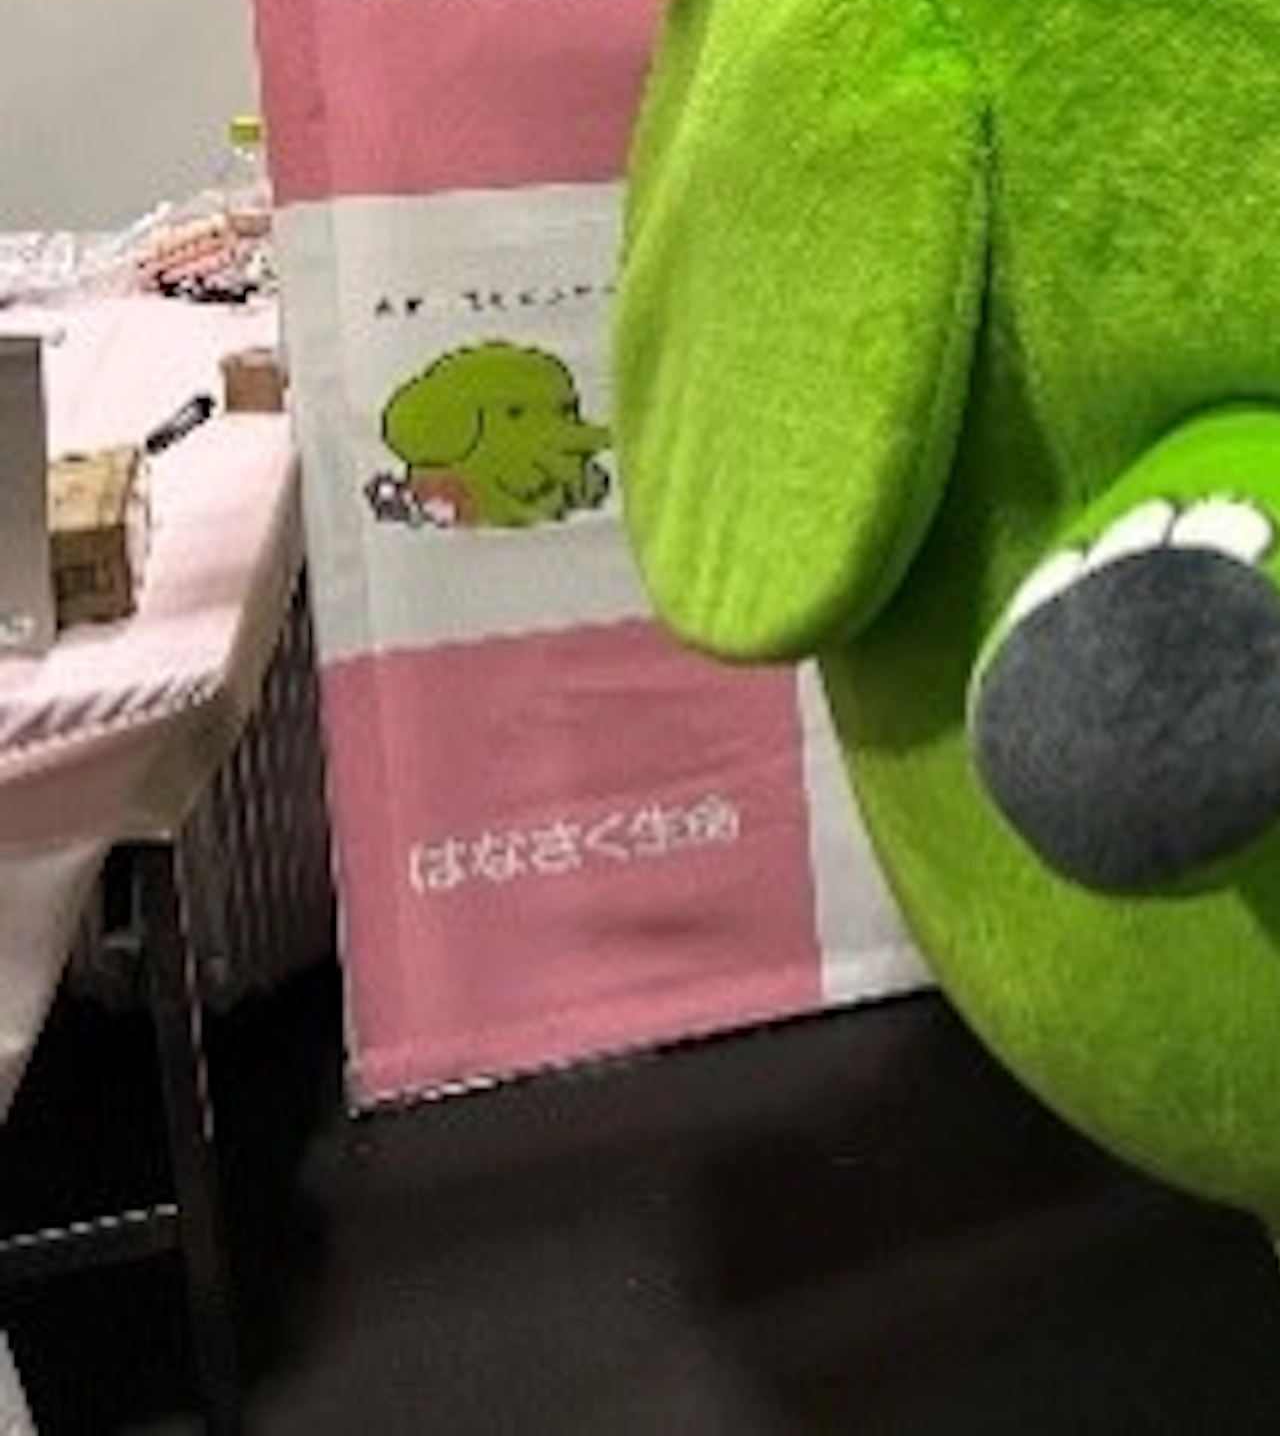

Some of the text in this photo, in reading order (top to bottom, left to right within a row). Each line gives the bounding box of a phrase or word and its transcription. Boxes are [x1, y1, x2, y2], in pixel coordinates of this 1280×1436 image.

[407, 794, 741, 895] はなさく生命
